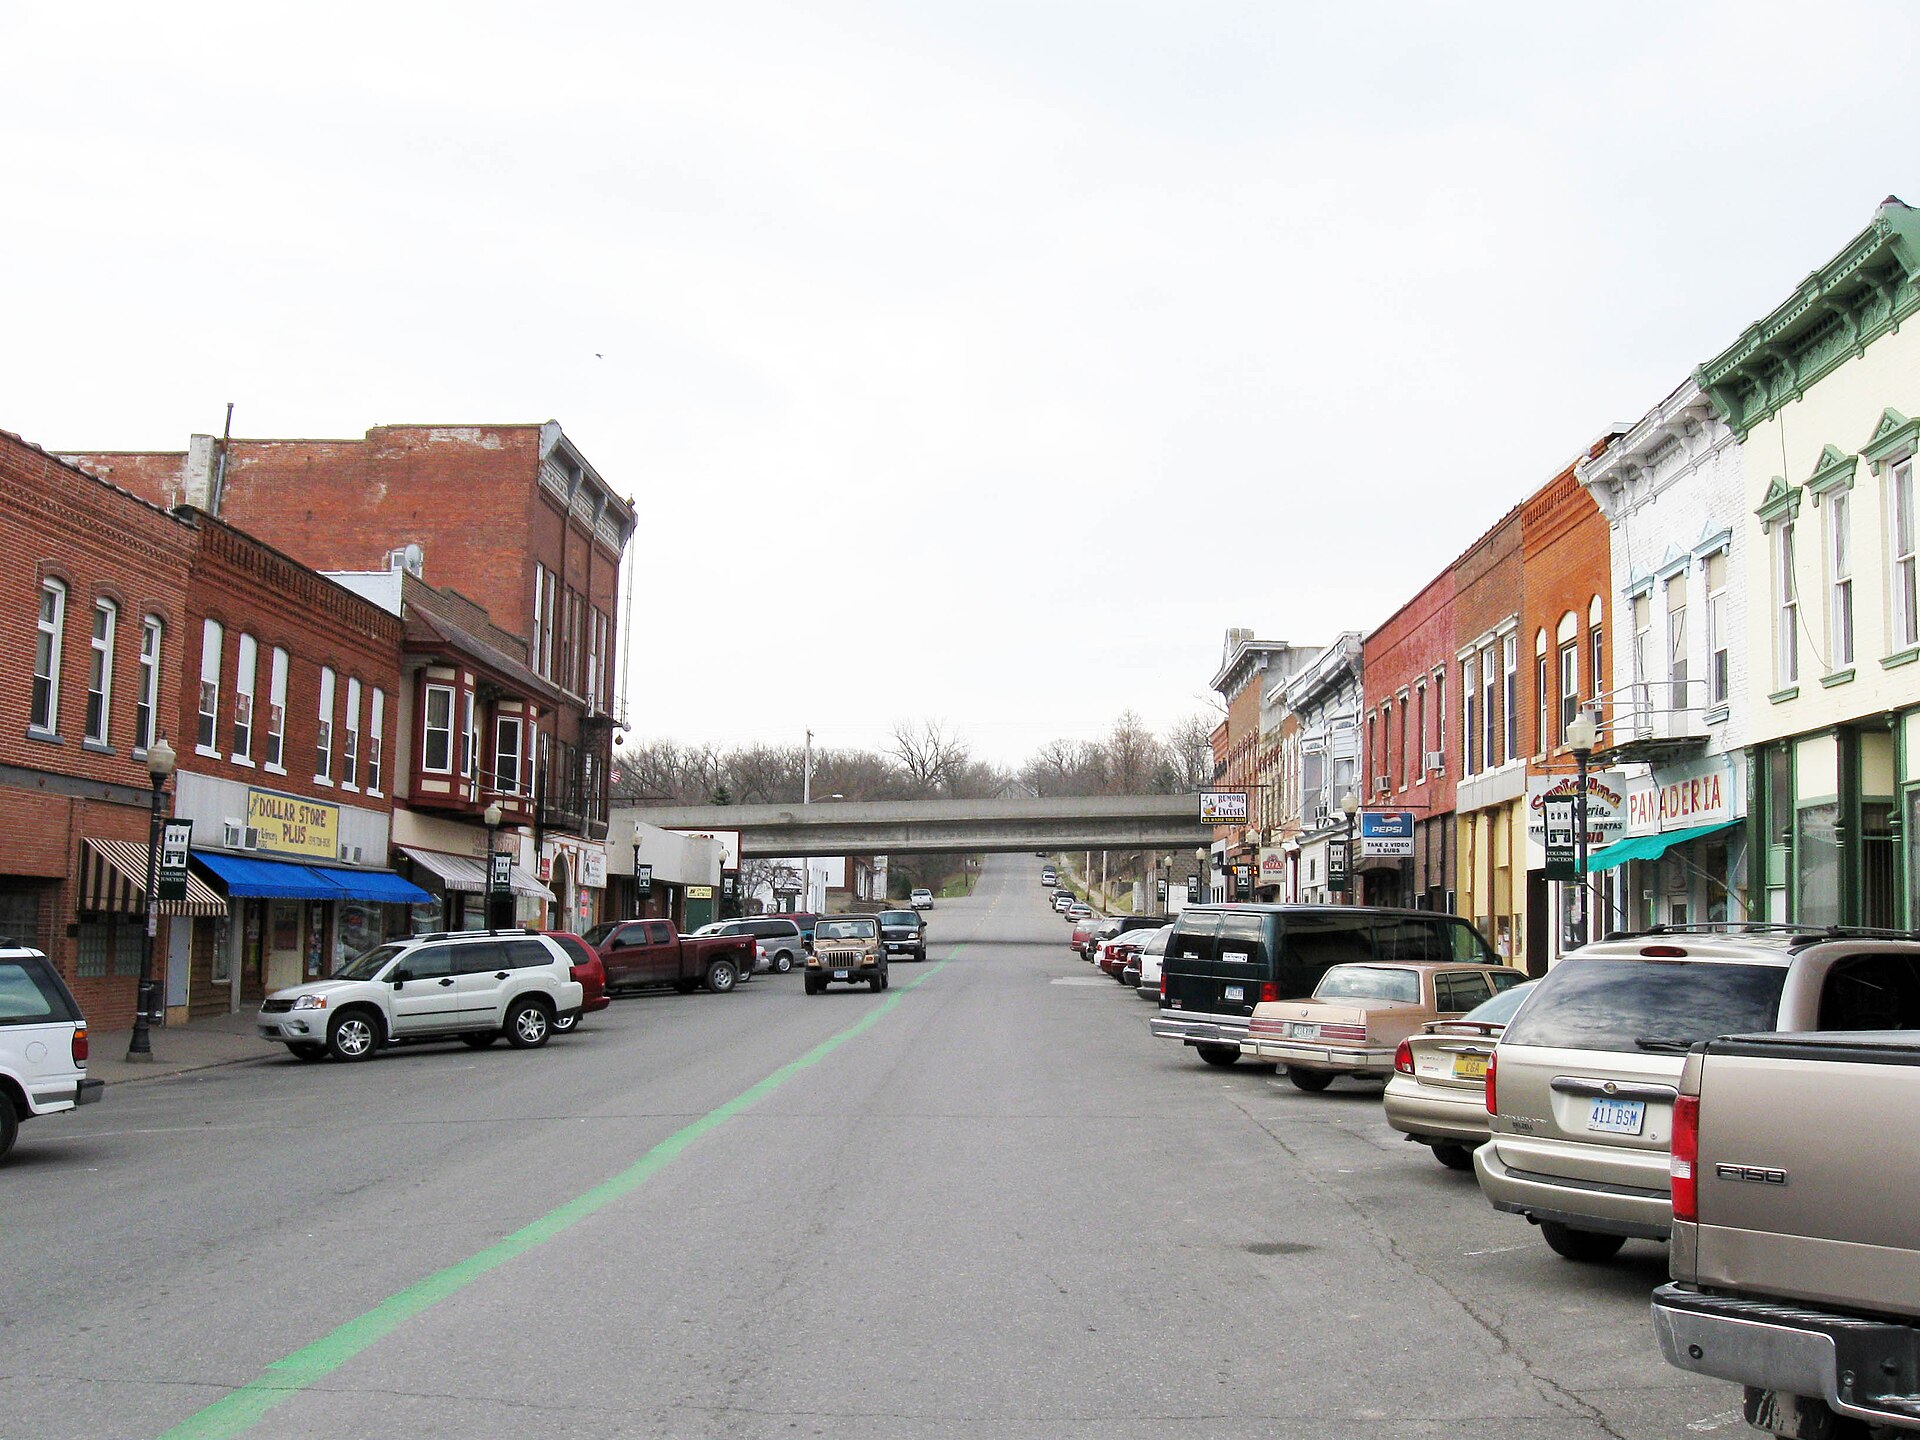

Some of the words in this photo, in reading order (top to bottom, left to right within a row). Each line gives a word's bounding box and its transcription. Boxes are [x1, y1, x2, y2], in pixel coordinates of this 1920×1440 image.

[1218, 795, 1245, 804] RUMORS
[1586, 777, 1622, 809] Ana
[1630, 774, 1721, 826] PANADERIA
[259, 797, 296, 822] DOLLAR
[299, 805, 327, 828] STORE
[1218, 807, 1245, 816] EXCUSES
[282, 822, 308, 844] PLUS
[1594, 823, 1623, 833] TORTAS
[1592, 1107, 1611, 1124] 411
[1616, 1109, 1638, 1127] BSM
